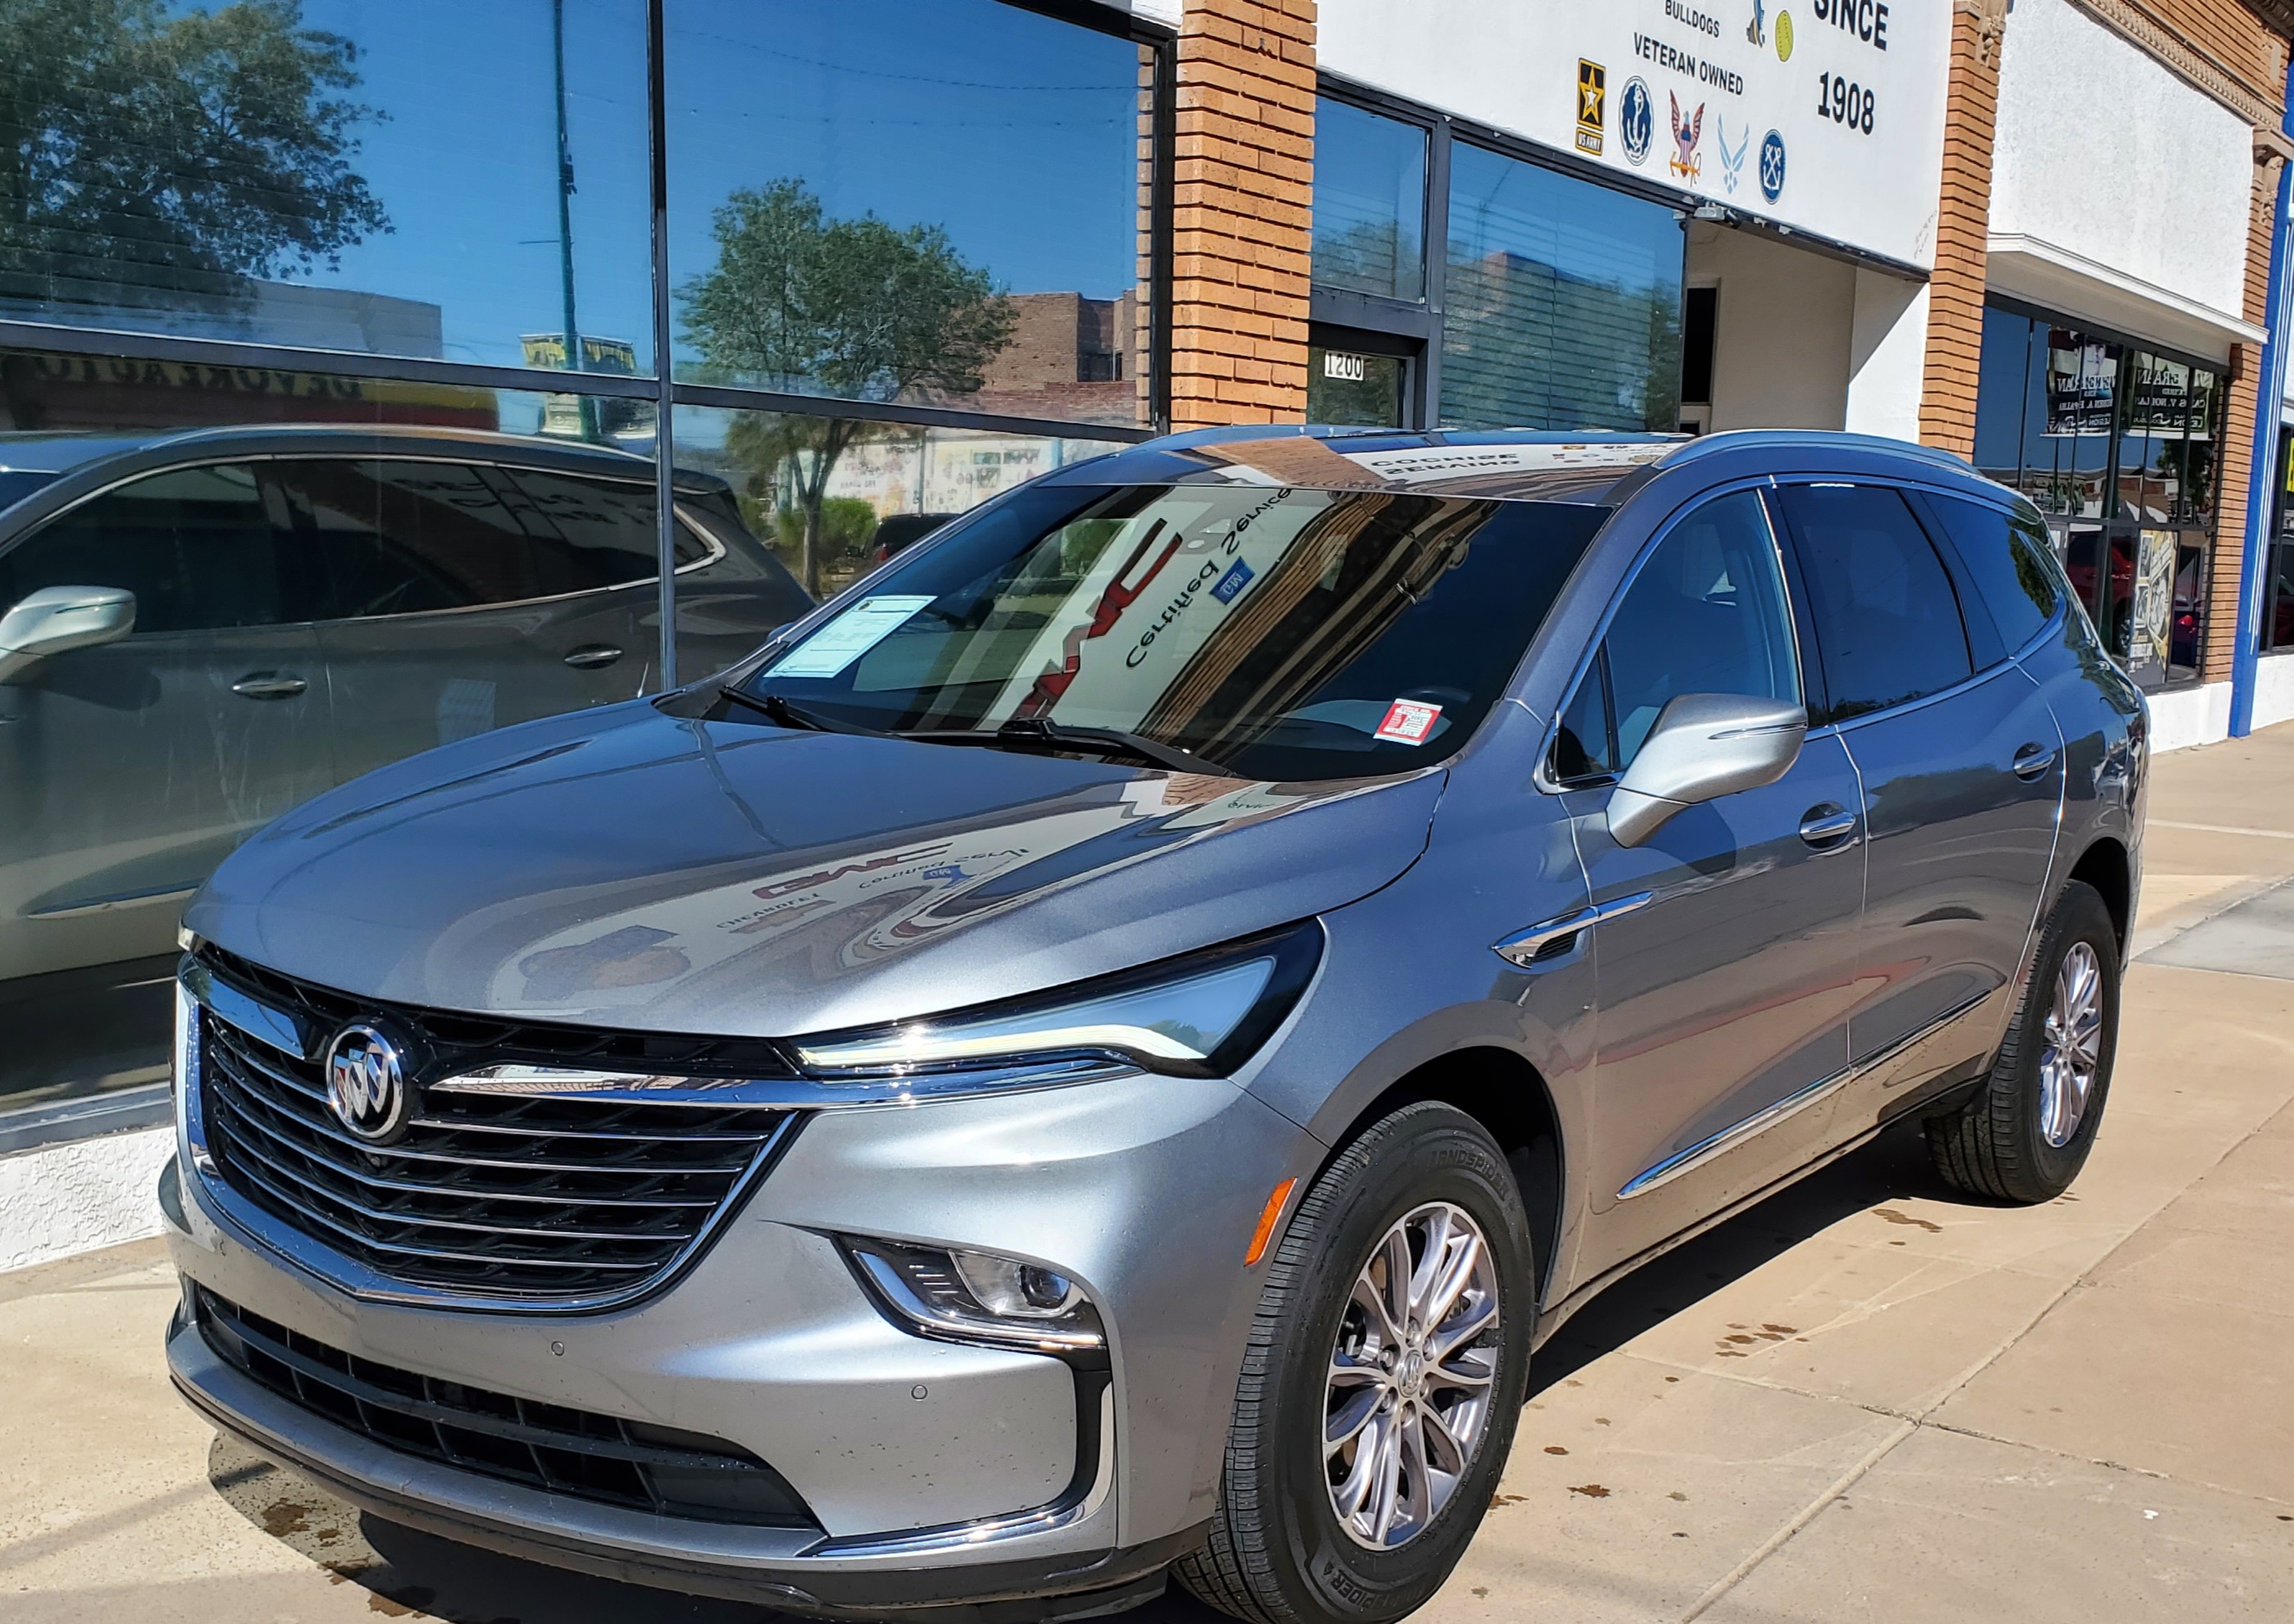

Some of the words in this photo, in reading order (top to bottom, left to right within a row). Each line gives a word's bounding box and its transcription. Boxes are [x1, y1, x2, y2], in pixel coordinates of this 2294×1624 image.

[1665, 0, 1720, 38] BULLDOGS
[1634, 32, 1695, 78] VETERAN
[1699, 60, 1743, 96] OWNED
[1818, 71, 1874, 135] 1908
[1327, 352, 1363, 379] 1200
